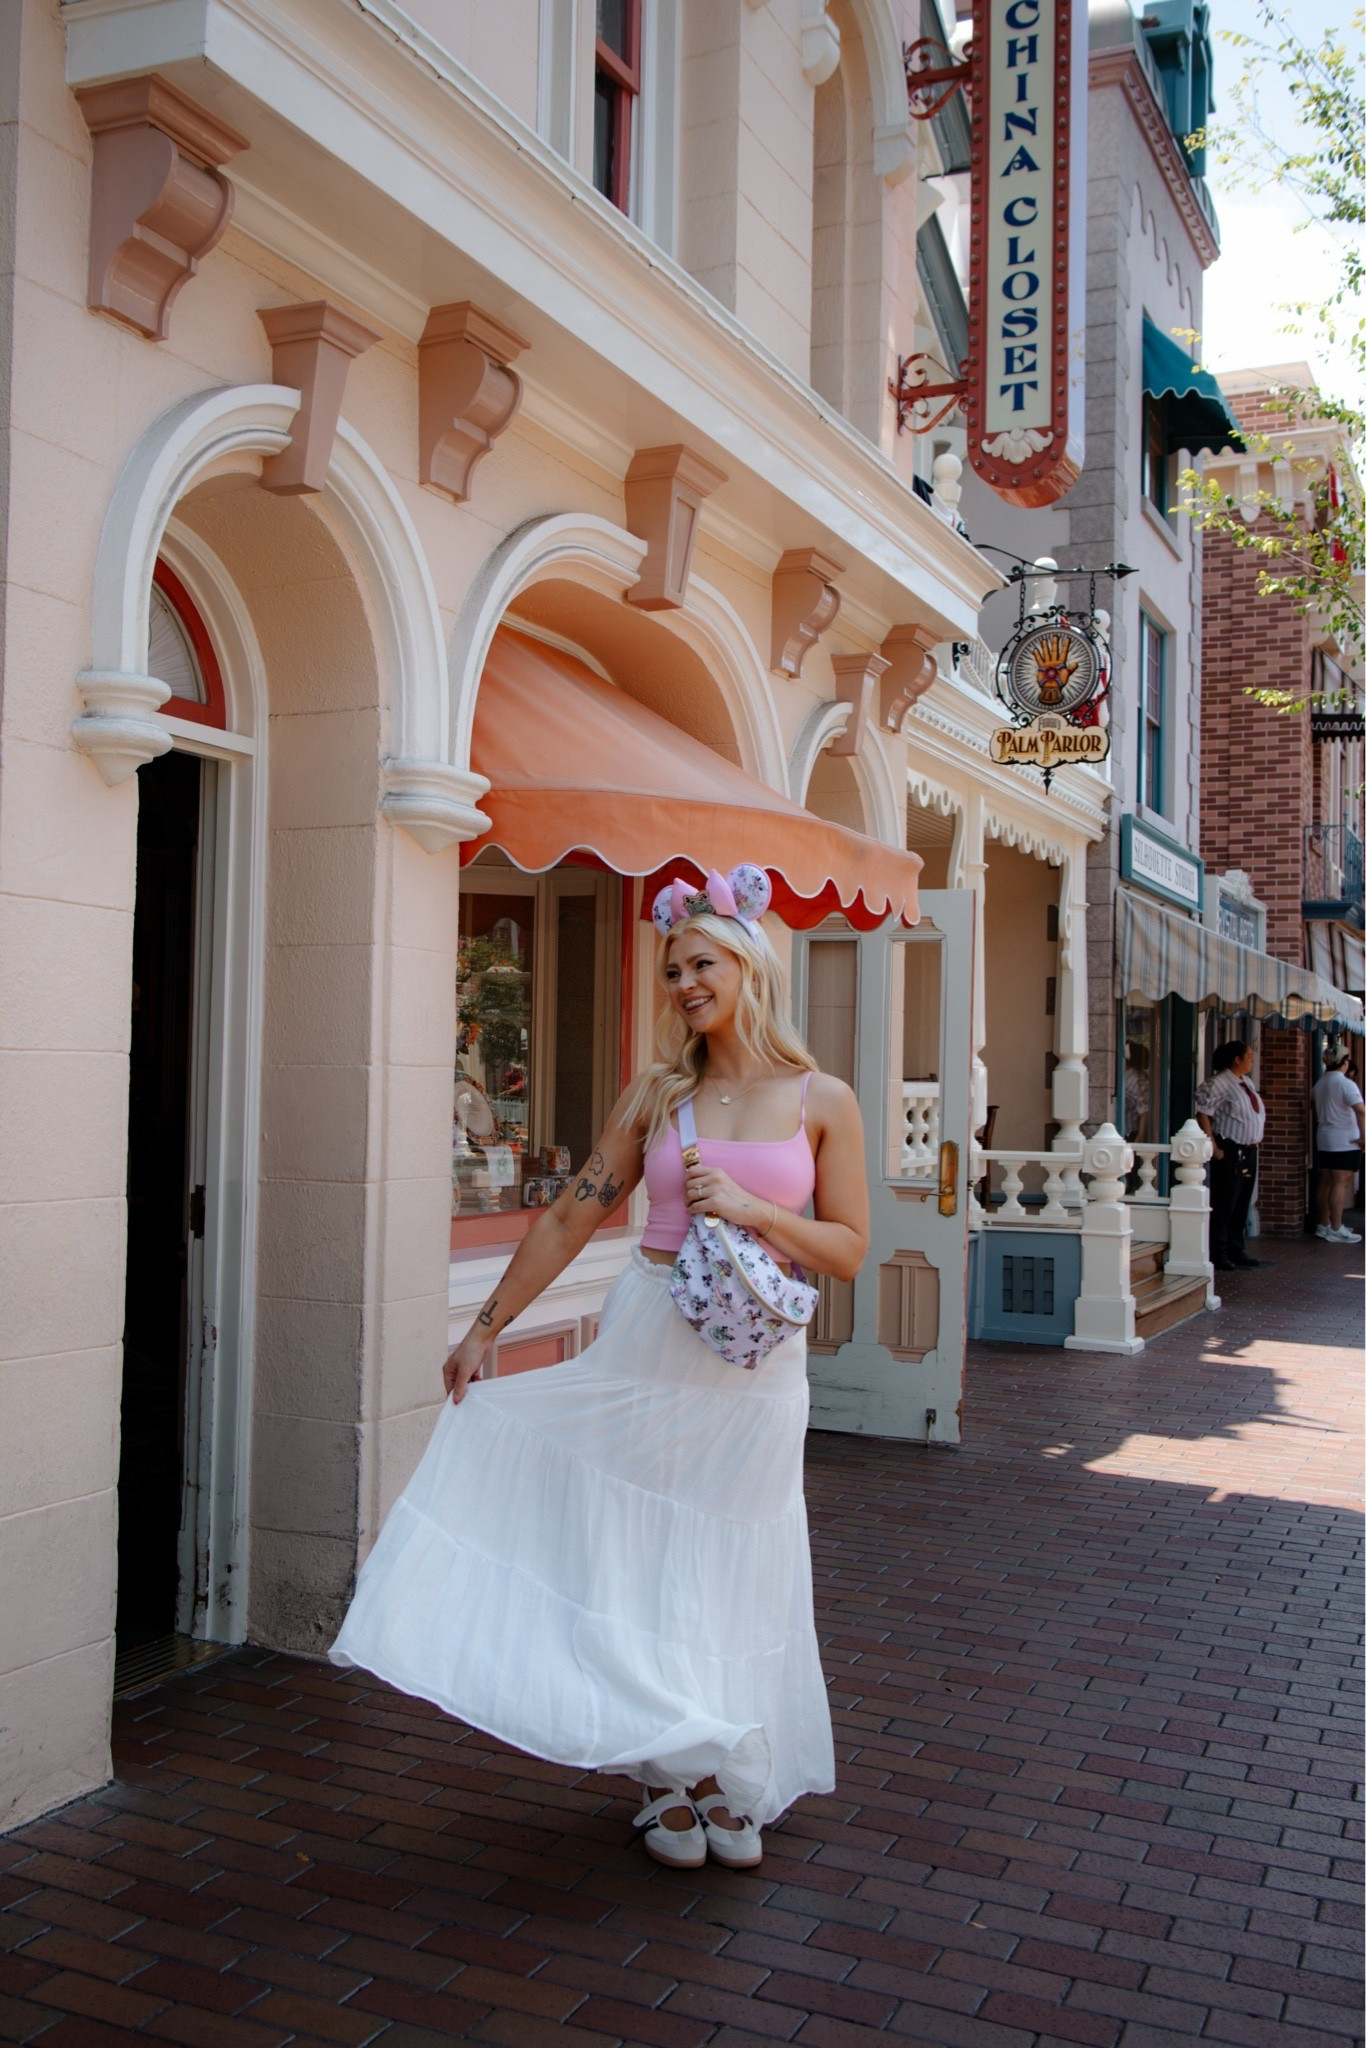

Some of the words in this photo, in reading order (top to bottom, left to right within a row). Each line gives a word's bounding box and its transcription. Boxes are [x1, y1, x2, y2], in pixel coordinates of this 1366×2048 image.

[1000, 0, 1041, 178] CHINA
[1000, 197, 1041, 412] CLOSET
[997, 731, 1039, 761] PALM
[1041, 730, 1102, 764] PARLOR
